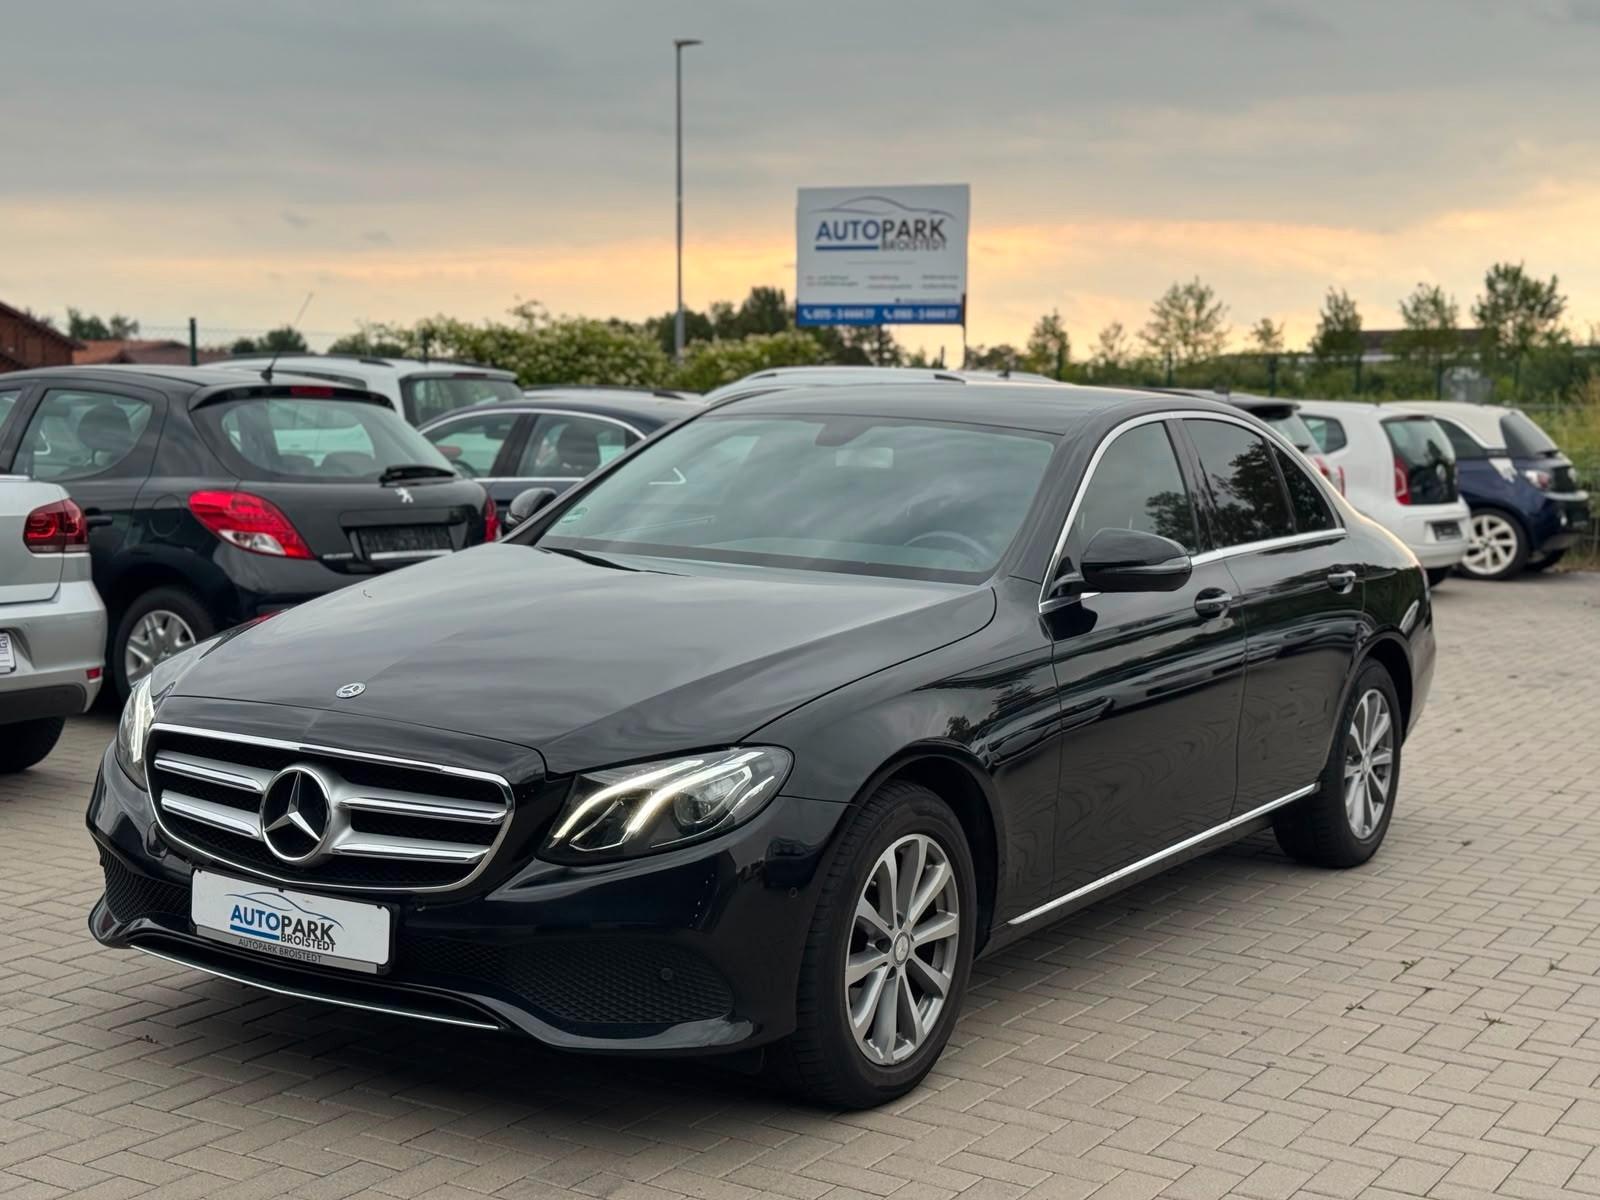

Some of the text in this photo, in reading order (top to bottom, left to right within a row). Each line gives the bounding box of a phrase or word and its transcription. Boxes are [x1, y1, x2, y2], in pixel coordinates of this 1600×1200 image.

[815, 219, 946, 241] AUTOPARK
[230, 904, 336, 944] AUTOPARK
[238, 938, 322, 963] AUTOPARK BROISTEDT
[280, 933, 336, 952] BROISTEDT
